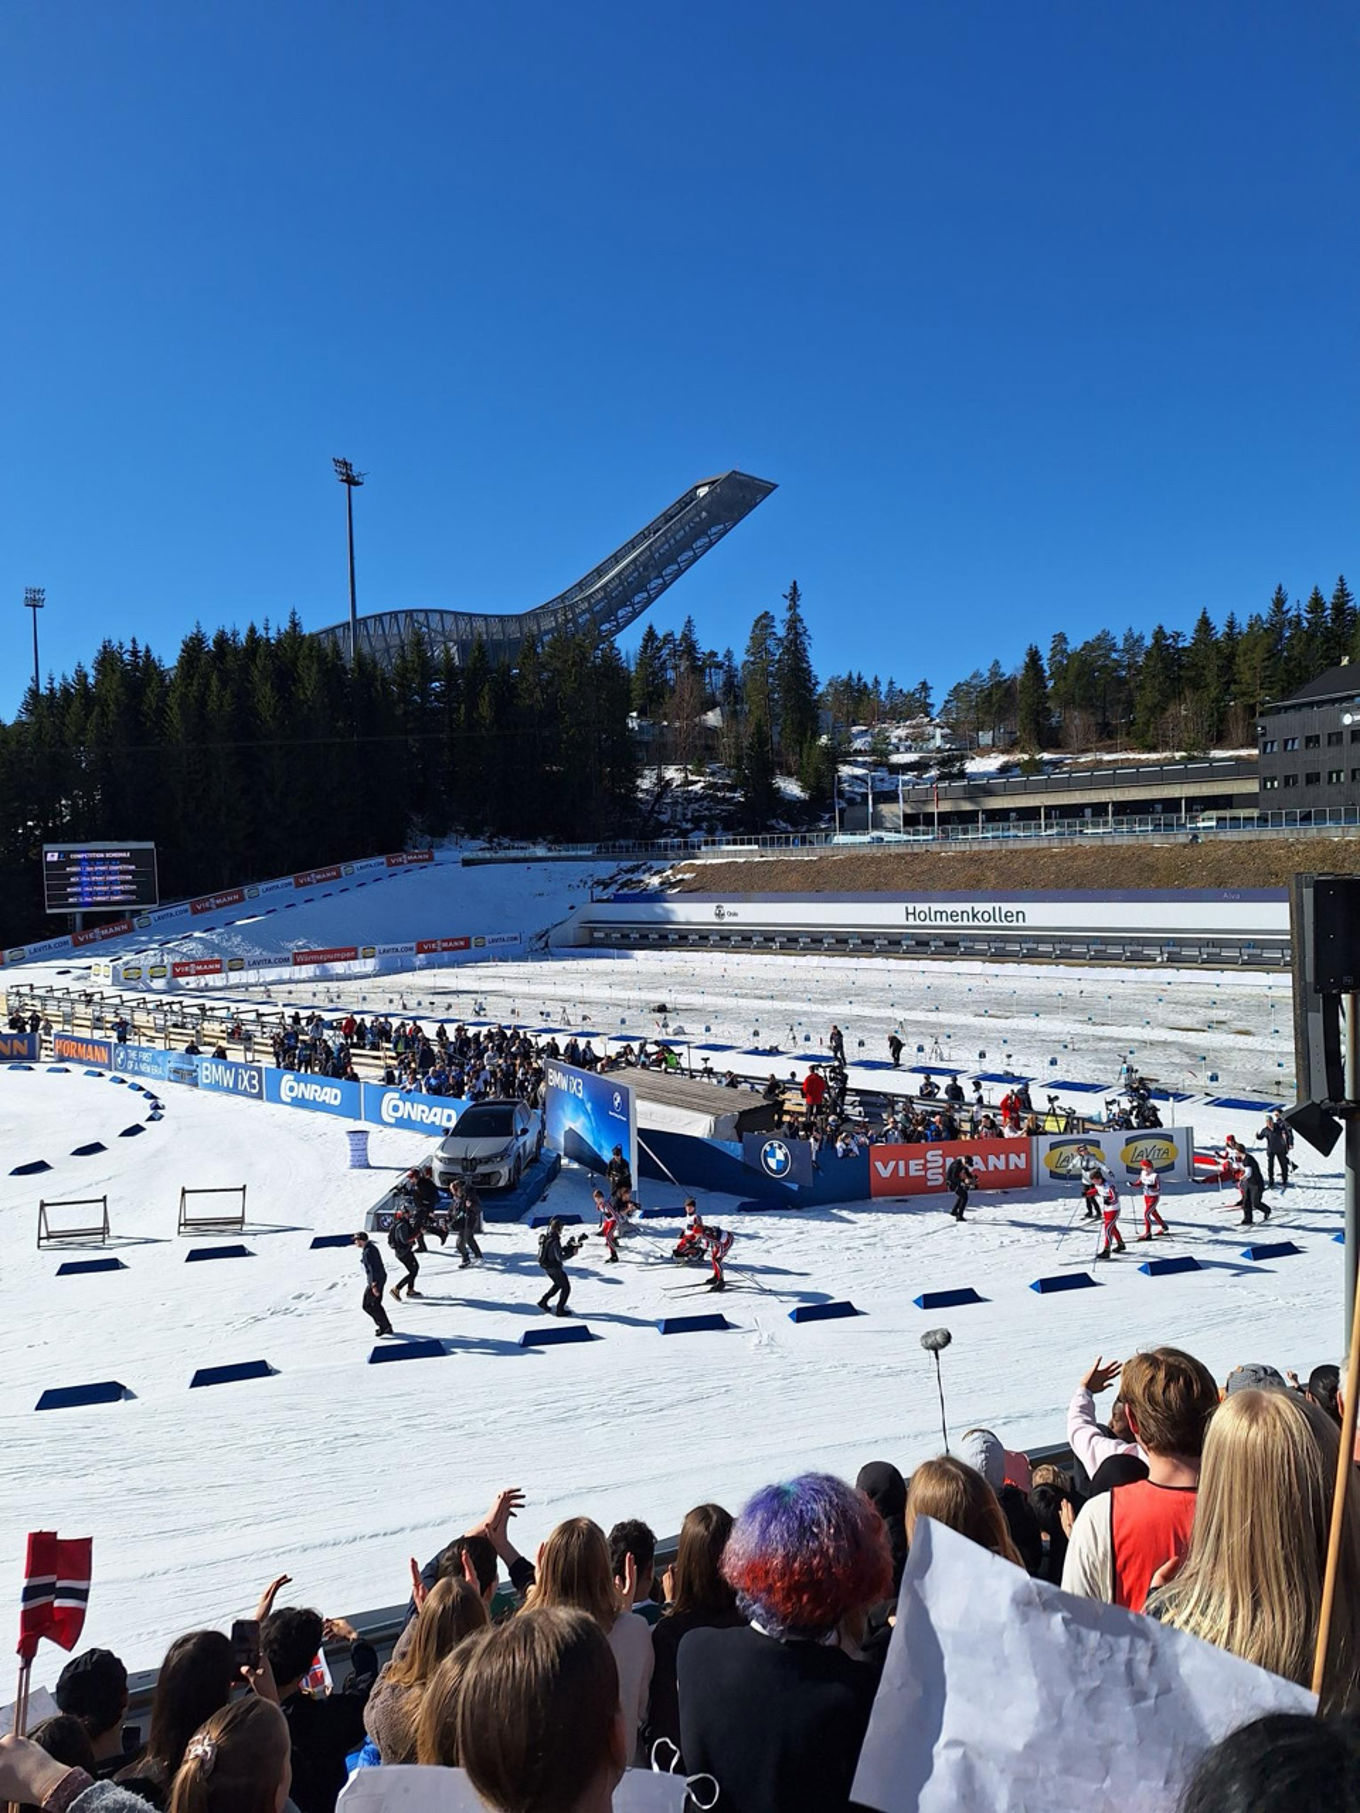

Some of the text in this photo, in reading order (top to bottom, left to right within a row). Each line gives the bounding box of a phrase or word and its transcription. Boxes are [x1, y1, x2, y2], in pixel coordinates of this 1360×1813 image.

[904, 905, 1027, 924] Holmenkollen
[28, 939, 70, 956] LAVITA.COM
[247, 956, 291, 967] LAVITA.COM
[201, 1062, 260, 1094] BMW iX3
[280, 1073, 342, 1106] CONRAD
[547, 1068, 569, 1092] BMW
[380, 1091, 458, 1128] CONRAD
[873, 1149, 1027, 1187] VIESSANN
